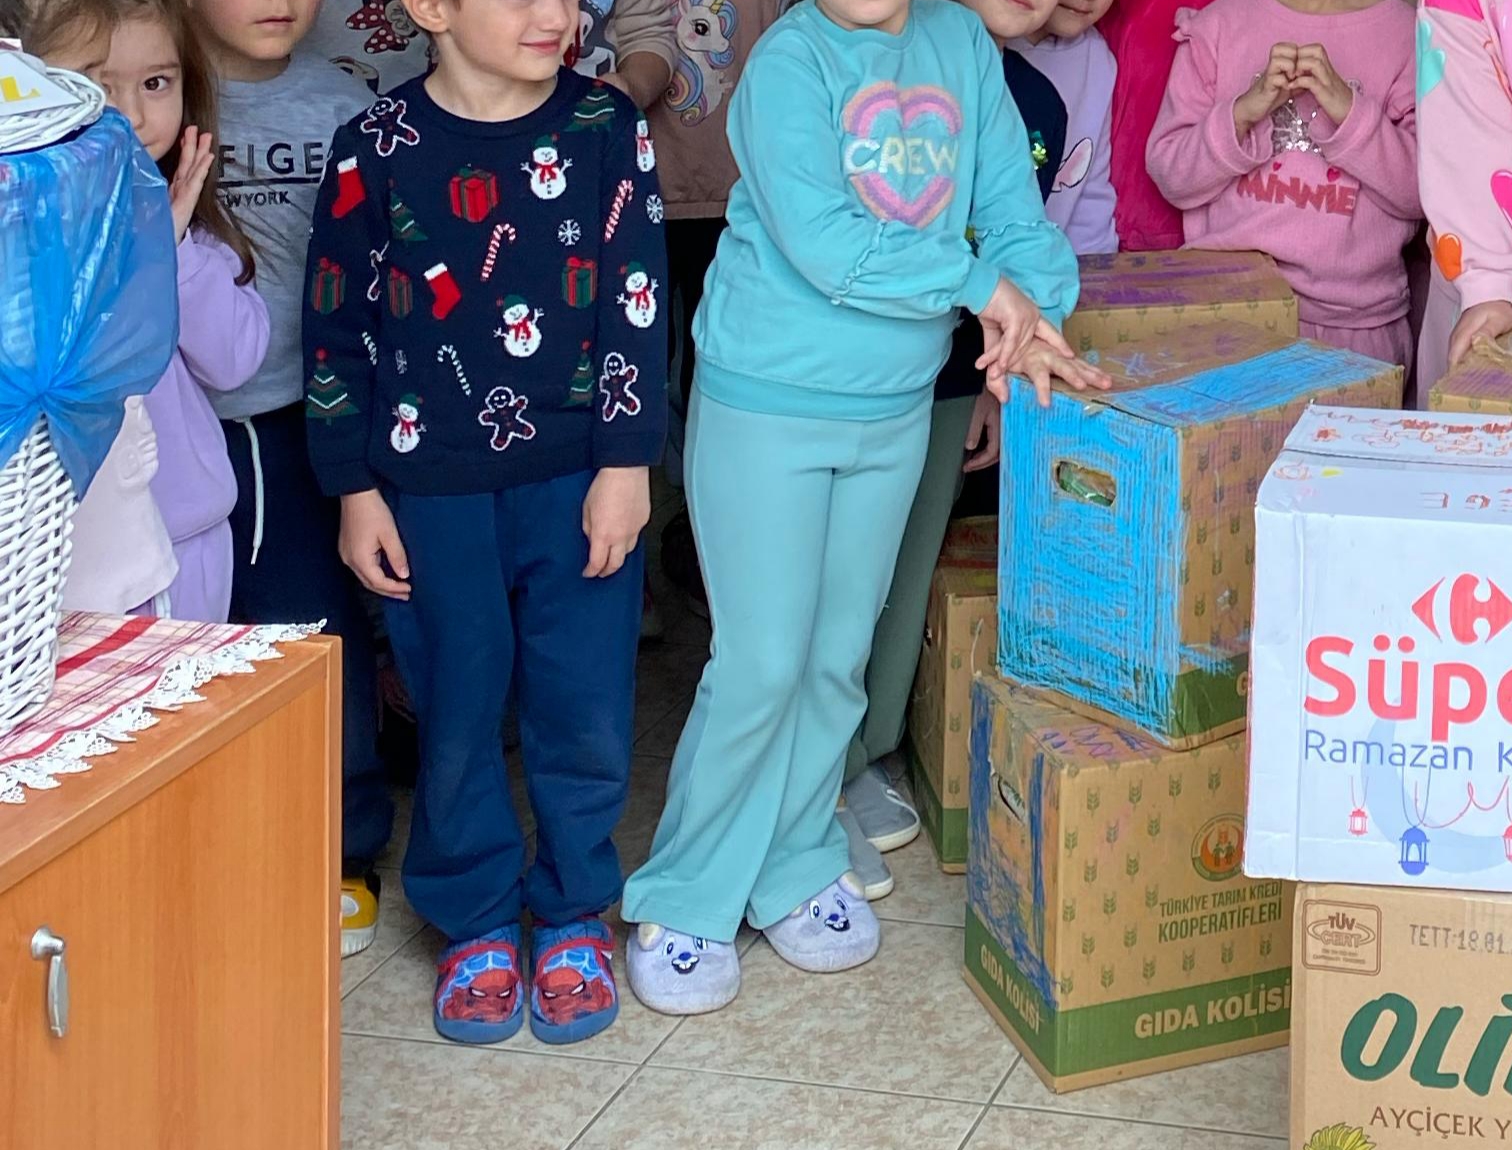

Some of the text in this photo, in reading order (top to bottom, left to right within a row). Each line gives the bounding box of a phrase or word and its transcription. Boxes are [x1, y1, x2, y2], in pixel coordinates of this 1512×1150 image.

[844, 136, 960, 175] CREW
[1304, 729, 1473, 771] Ramazan
[1159, 892, 1210, 918] TÜRKİYE
[1249, 880, 1283, 901] KREDİ
[1158, 898, 1282, 944] KOOPERATİFLERİ
[1328, 912, 1356, 930] TÜV
[980, 944, 1004, 991] GIDA
[1134, 979, 1291, 1039] GIDA KOLİSİ
[1369, 1105, 1485, 1138] AYÇİÇEK
